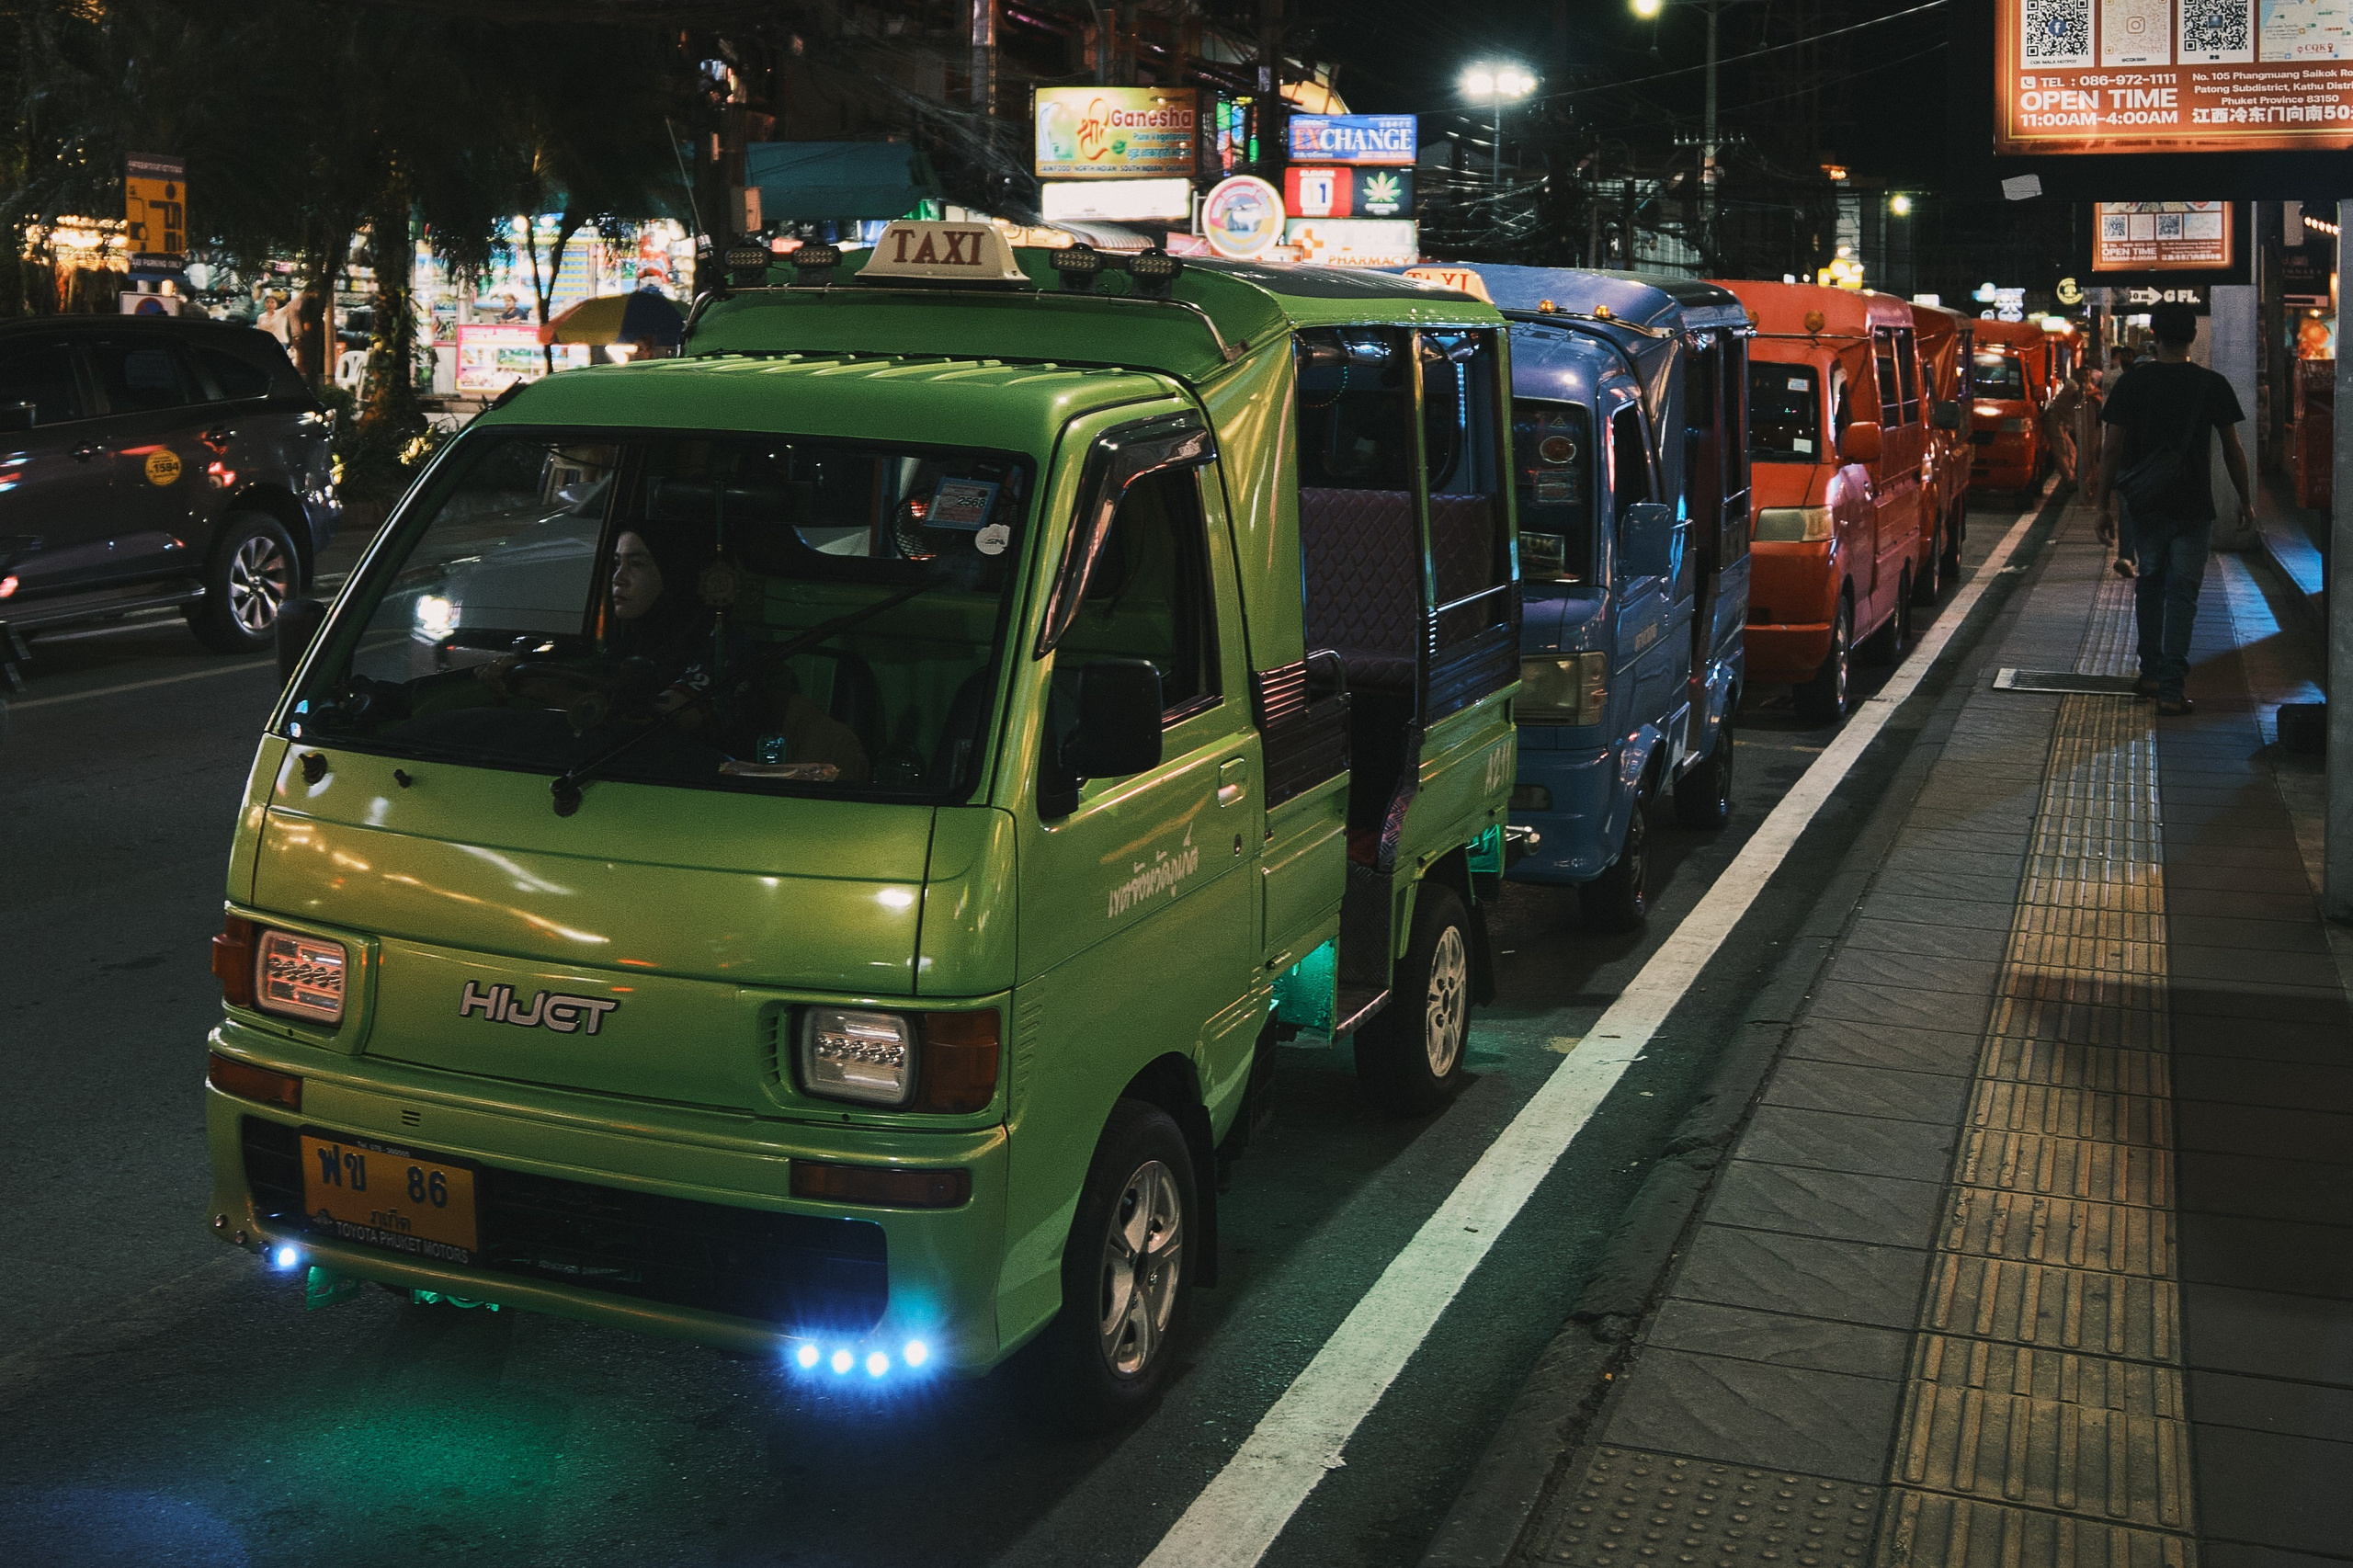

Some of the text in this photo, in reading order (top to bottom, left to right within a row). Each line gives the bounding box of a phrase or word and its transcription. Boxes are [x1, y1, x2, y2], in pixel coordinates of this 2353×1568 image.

[2040, 77, 2065, 87] TEL
[2079, 74, 2177, 86] 086-972-1111
[2192, 73, 2209, 81] No.
[2211, 72, 2231, 80] 105
[2233, 71, 2301, 80] Phangmuang
[2194, 85, 2230, 94] Patong
[2233, 84, 2290, 93] Subdistrict,
[2293, 82, 2324, 91] Kathu
[2020, 88, 2178, 111] OPEN TIME
[2222, 95, 2339, 106] Phuket Province 83150
[1110, 107, 1194, 128] Ganesha
[2020, 110, 2178, 127] 11:00AM-4:00AM
[2192, 104, 2353, 124] 江西冷东门向南50
[1293, 128, 1412, 151] EXCHANGE
[890, 229, 985, 266] TAXI
[2102, 247, 2130, 256] OPEN
[2132, 246, 2157, 256] TIME
[1328, 255, 1411, 267] PHARMACY
[958, 496, 987, 508] 2568
[460, 980, 621, 1036] HIJET
[406, 1165, 448, 1209] 86
[336, 1221, 469, 1264] TOYOTA PHUKET MOTORS
